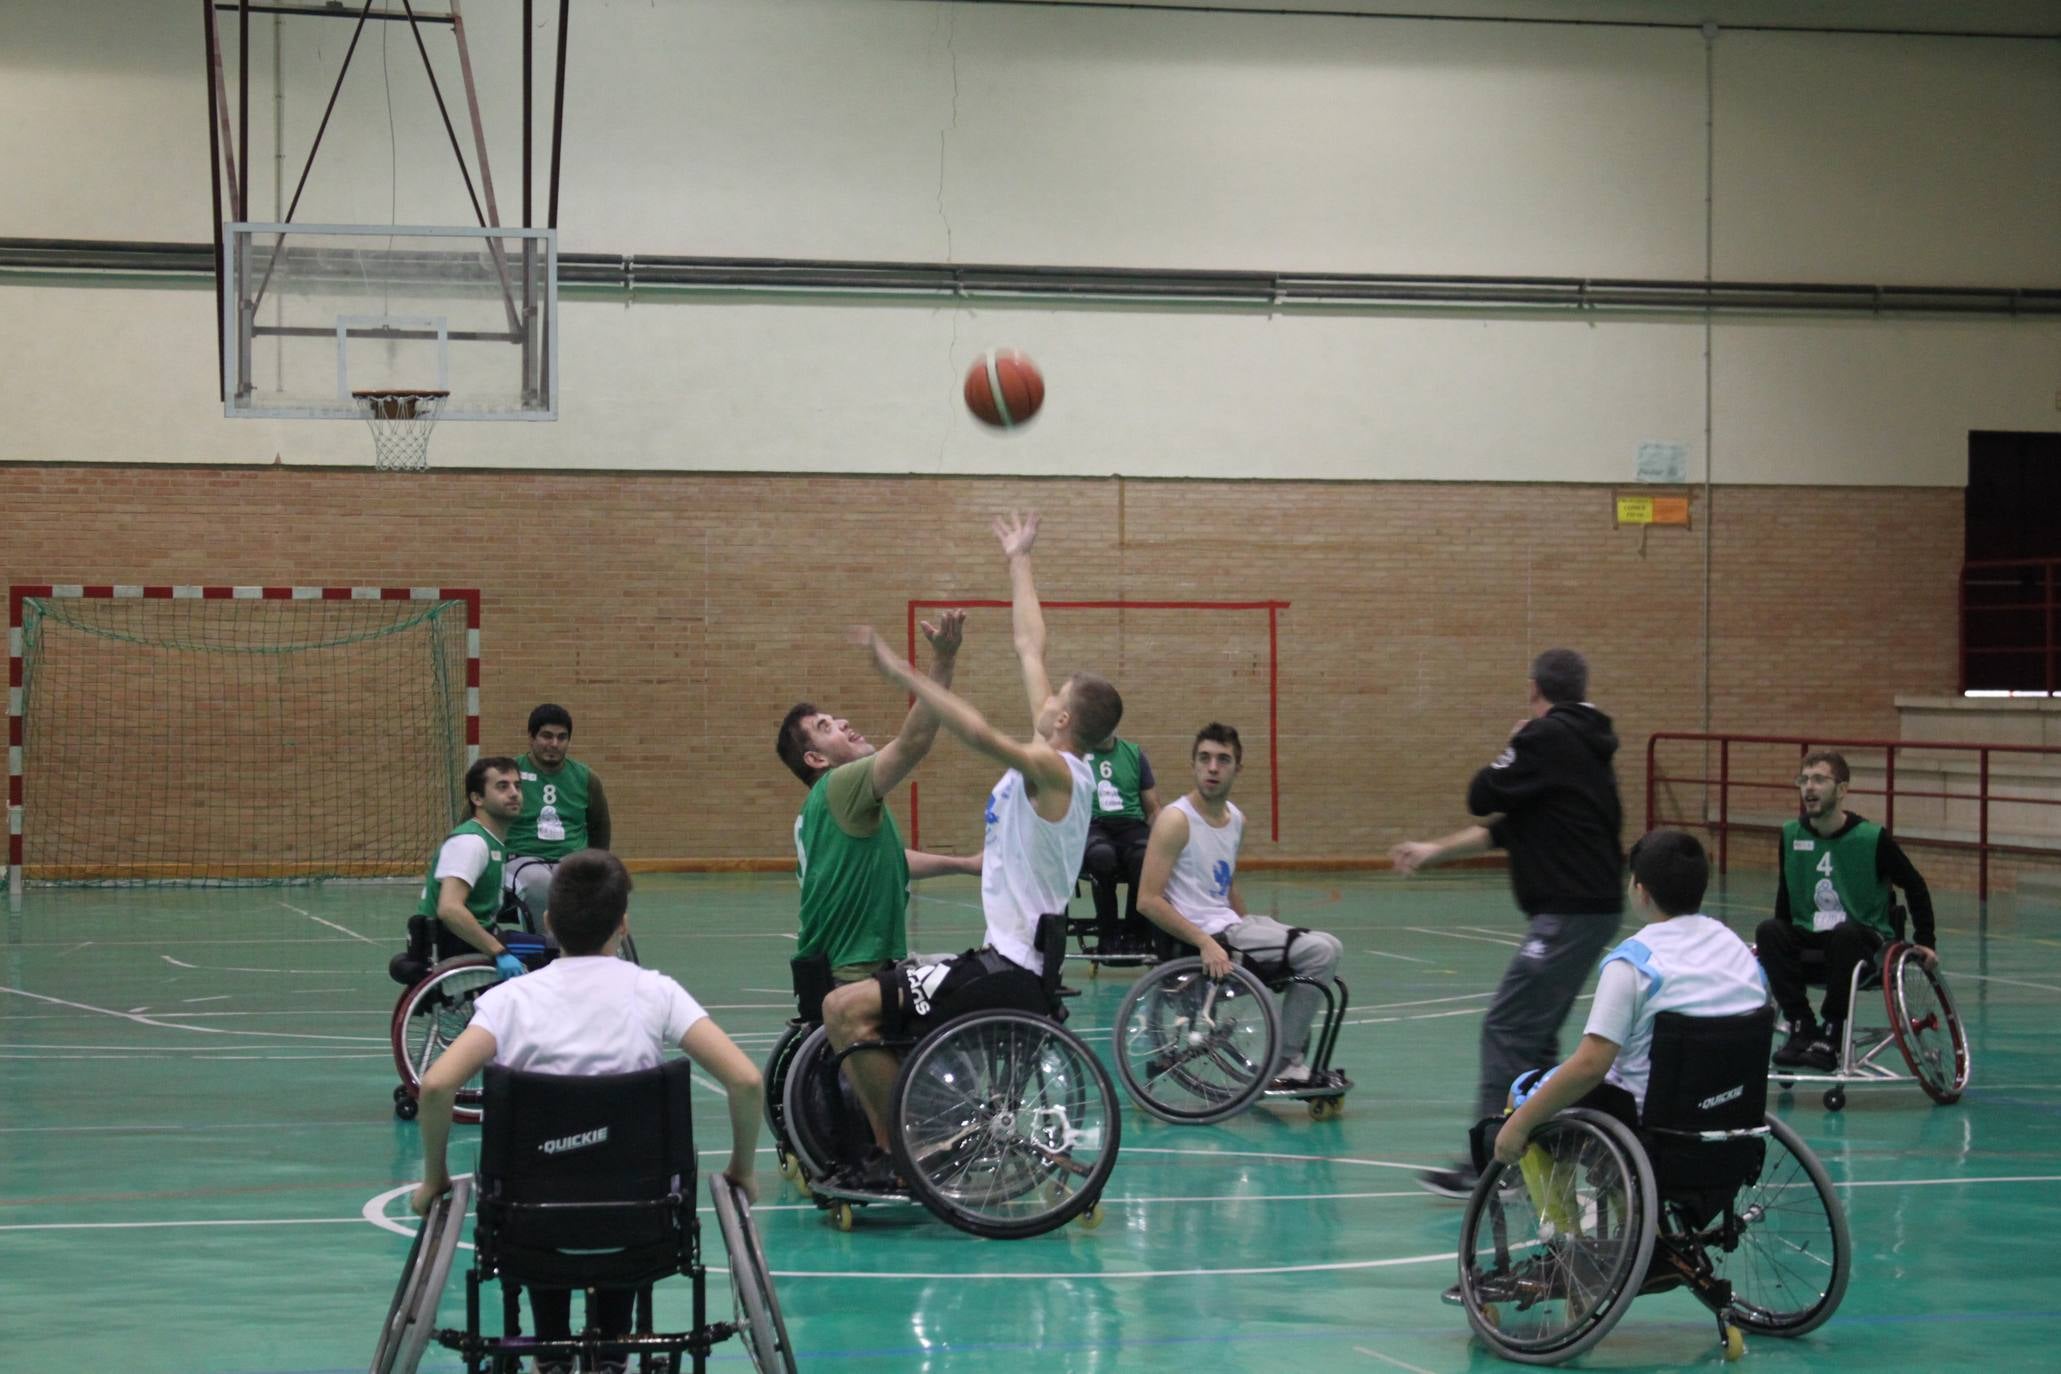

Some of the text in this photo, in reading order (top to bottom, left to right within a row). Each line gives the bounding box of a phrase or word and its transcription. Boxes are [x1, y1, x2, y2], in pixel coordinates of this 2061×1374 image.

[1100, 761, 1113, 780] 6
[543, 783, 557, 805] 8
[1816, 851, 1833, 877] 4
[543, 1126, 608, 1154] QUICKIE
